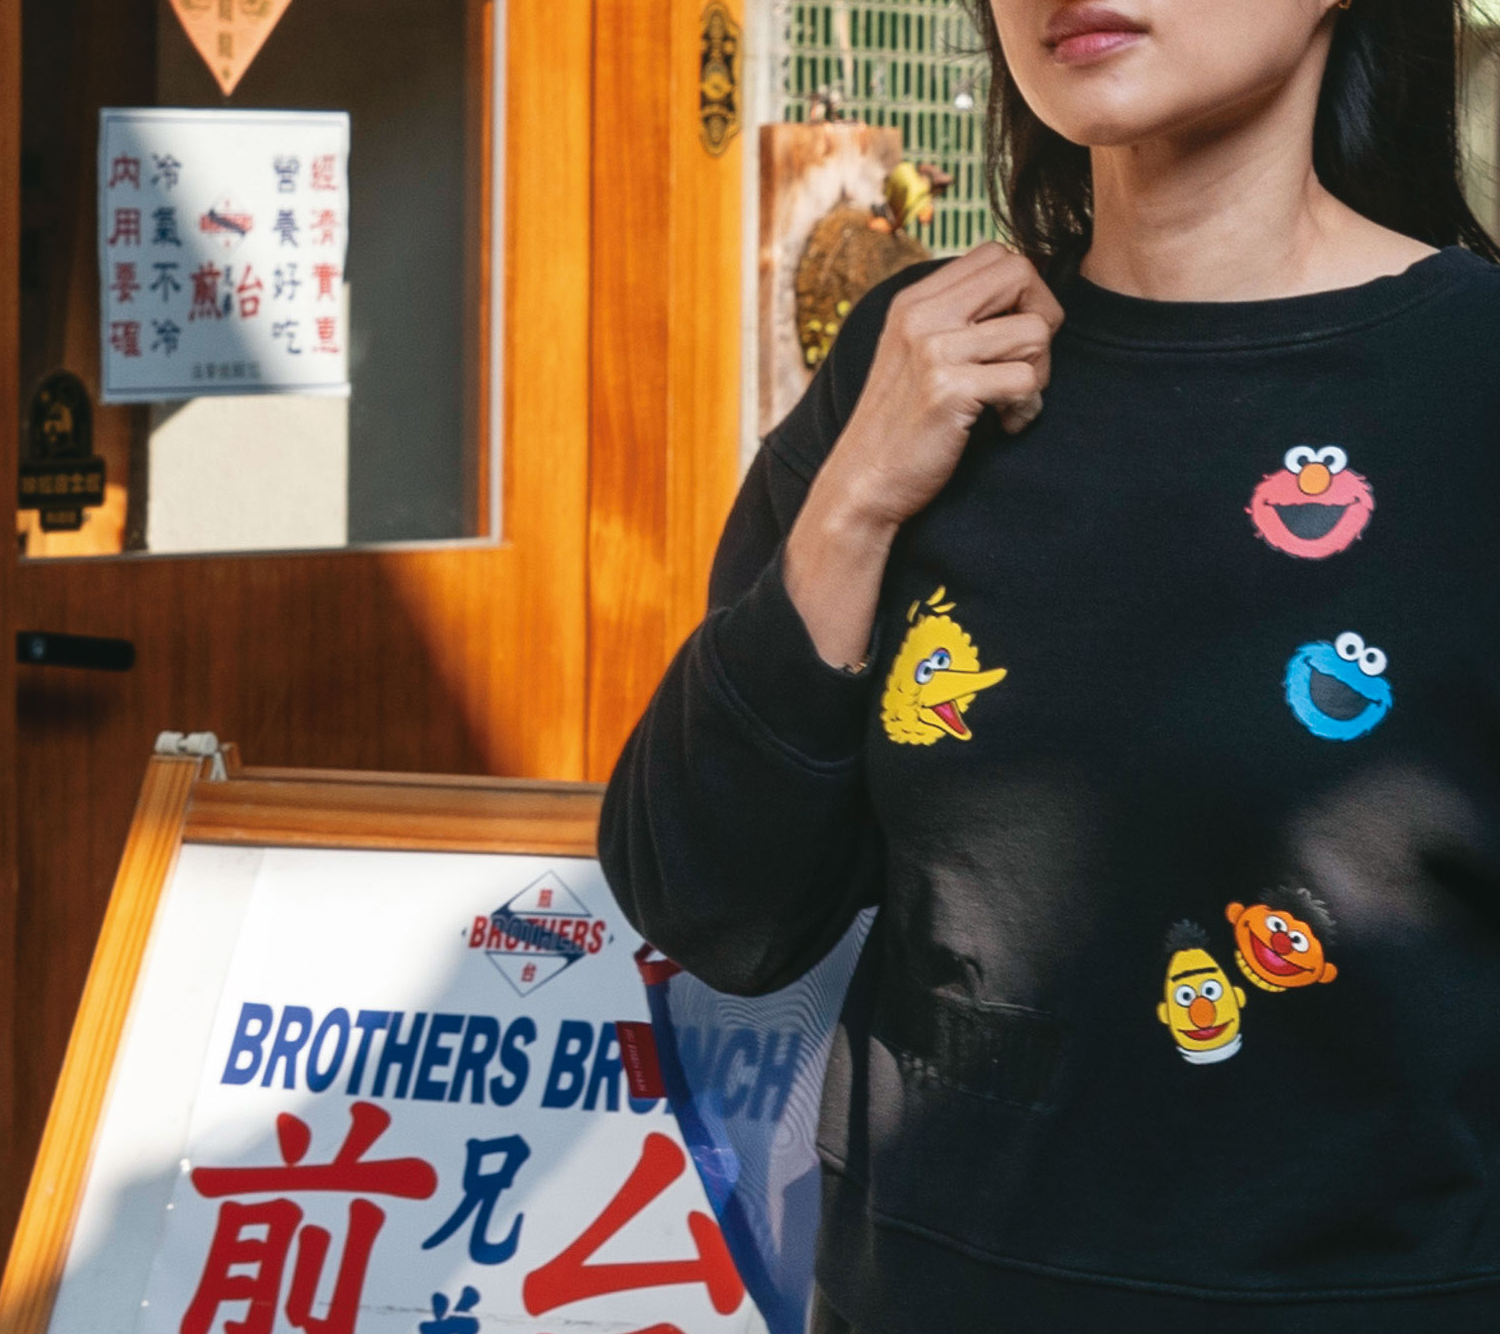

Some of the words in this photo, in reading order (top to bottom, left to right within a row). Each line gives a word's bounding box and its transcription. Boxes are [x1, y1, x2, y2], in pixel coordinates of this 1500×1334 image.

[151, 152, 183, 357] 冷氣不冷
[273, 156, 302, 355] 營養好吃
[311, 154, 340, 354] 經濟實惠
[468, 916, 606, 955] BROTHERS
[220, 1002, 537, 1107] BROTHERS
